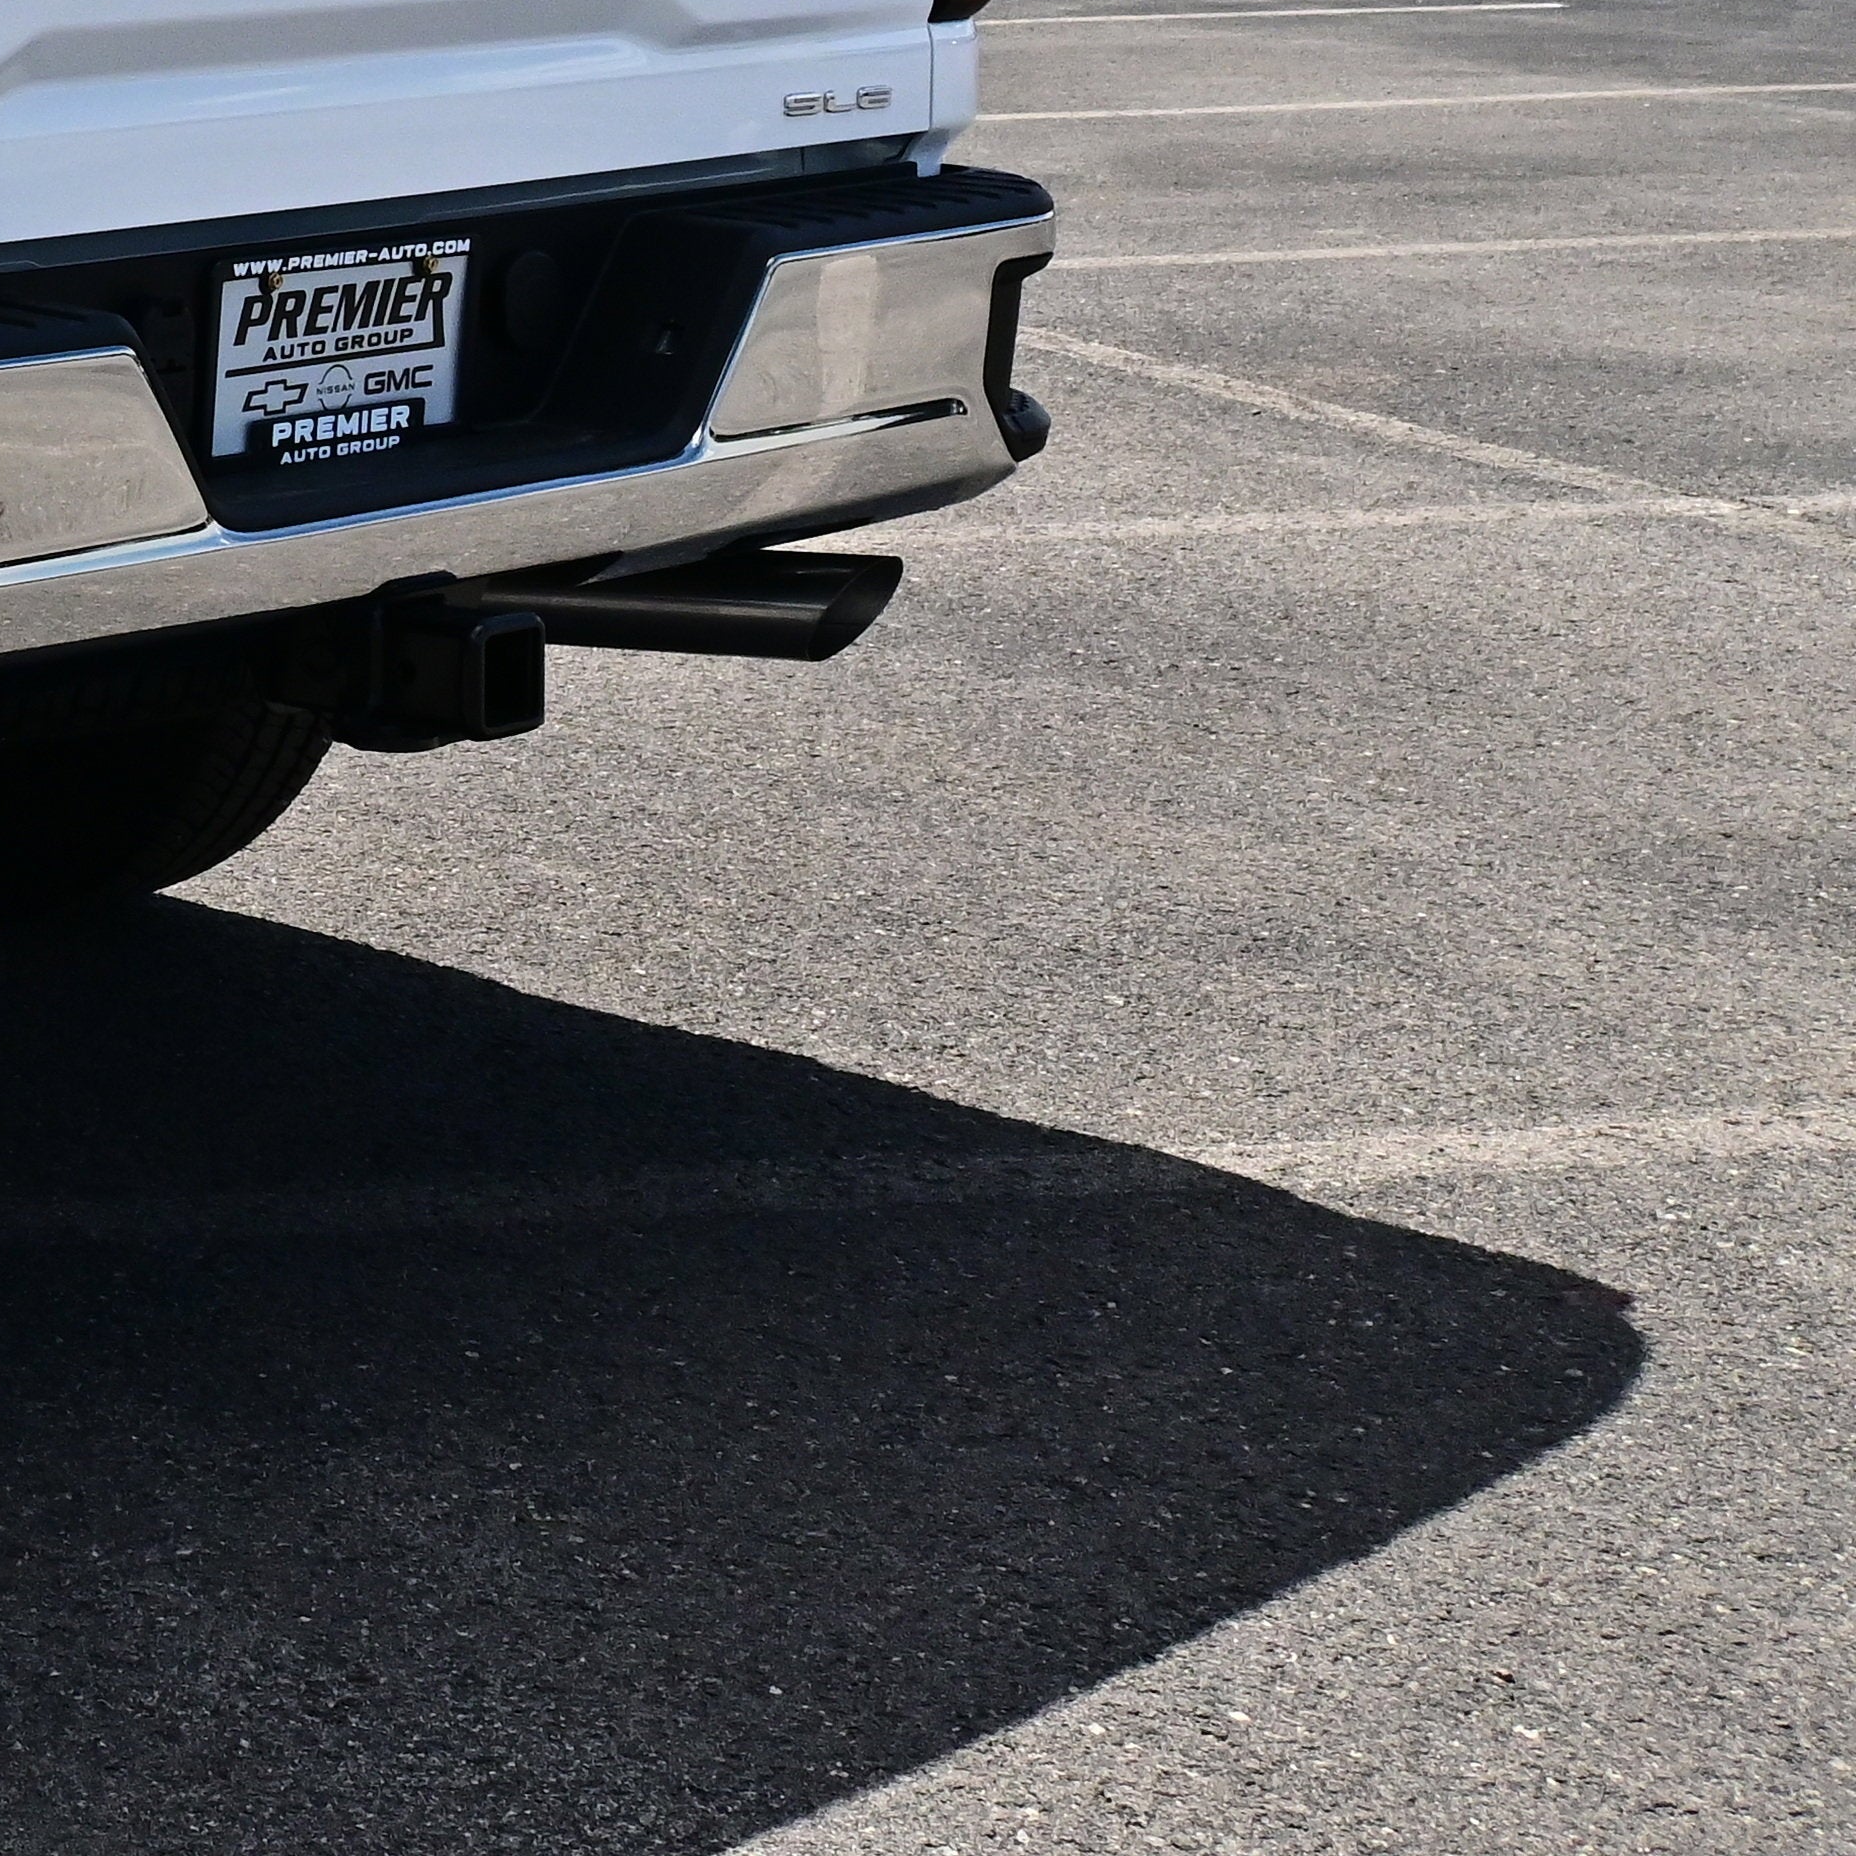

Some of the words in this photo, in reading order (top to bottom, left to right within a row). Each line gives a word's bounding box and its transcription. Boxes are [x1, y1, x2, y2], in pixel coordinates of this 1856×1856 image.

[783, 85, 892, 118] SLE
[233, 239, 470, 276] WWW.PREMIER-AUTO.COM
[233, 271, 453, 348] PREMIER
[263, 341, 327, 362] AUTO
[334, 328, 414, 352] GROUP
[316, 382, 356, 396] NISSAN
[363, 365, 434, 395] GMC
[271, 405, 410, 448] PREMIER
[280, 444, 331, 465] AUTO
[336, 436, 401, 457] GROUP
